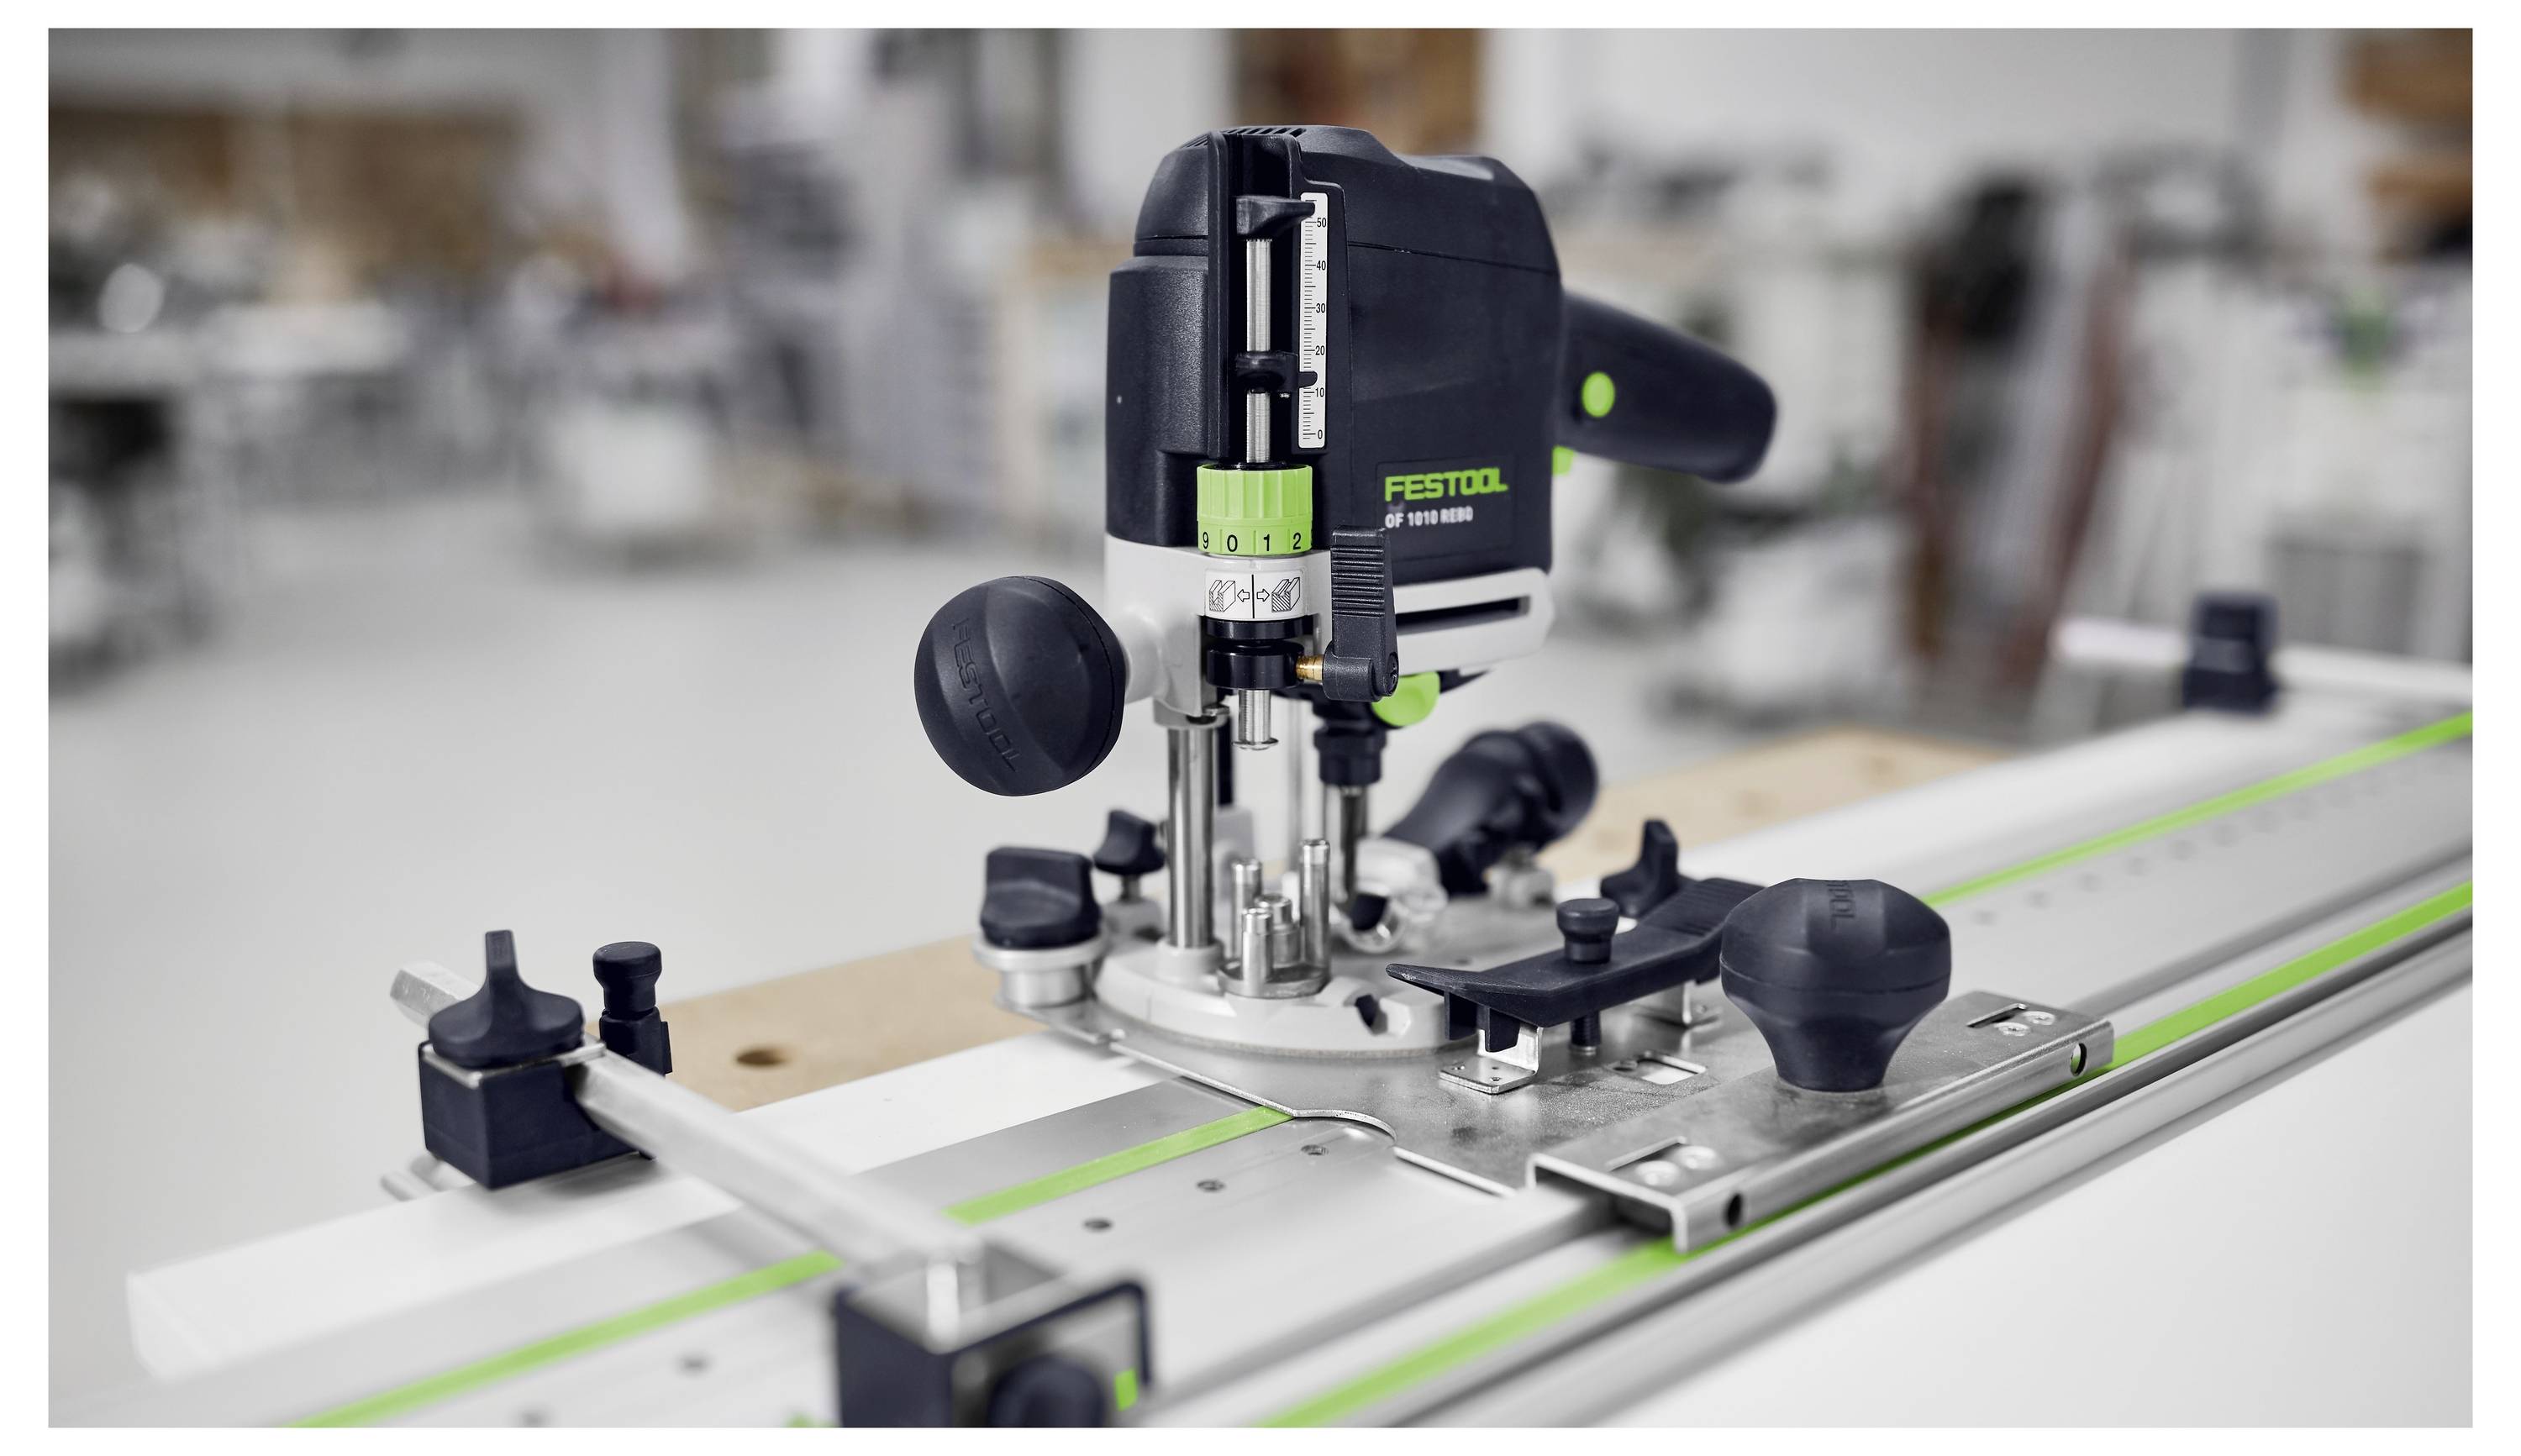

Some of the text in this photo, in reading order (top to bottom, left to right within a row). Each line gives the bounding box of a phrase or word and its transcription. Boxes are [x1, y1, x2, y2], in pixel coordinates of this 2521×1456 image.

[1317, 218, 1327, 228] 50
[1316, 260, 1326, 271] 40
[1315, 303, 1325, 313] 30
[1315, 345, 1325, 355] 20
[1315, 387, 1324, 397] 10
[1317, 429, 1323, 439] 0
[1385, 467, 1508, 502] FESTOOL
[1385, 512, 1404, 528] OF
[1408, 509, 1439, 527] 1010
[1203, 532, 1302, 552] 9 0 1 2
[952, 618, 1021, 773] FESTOOL
